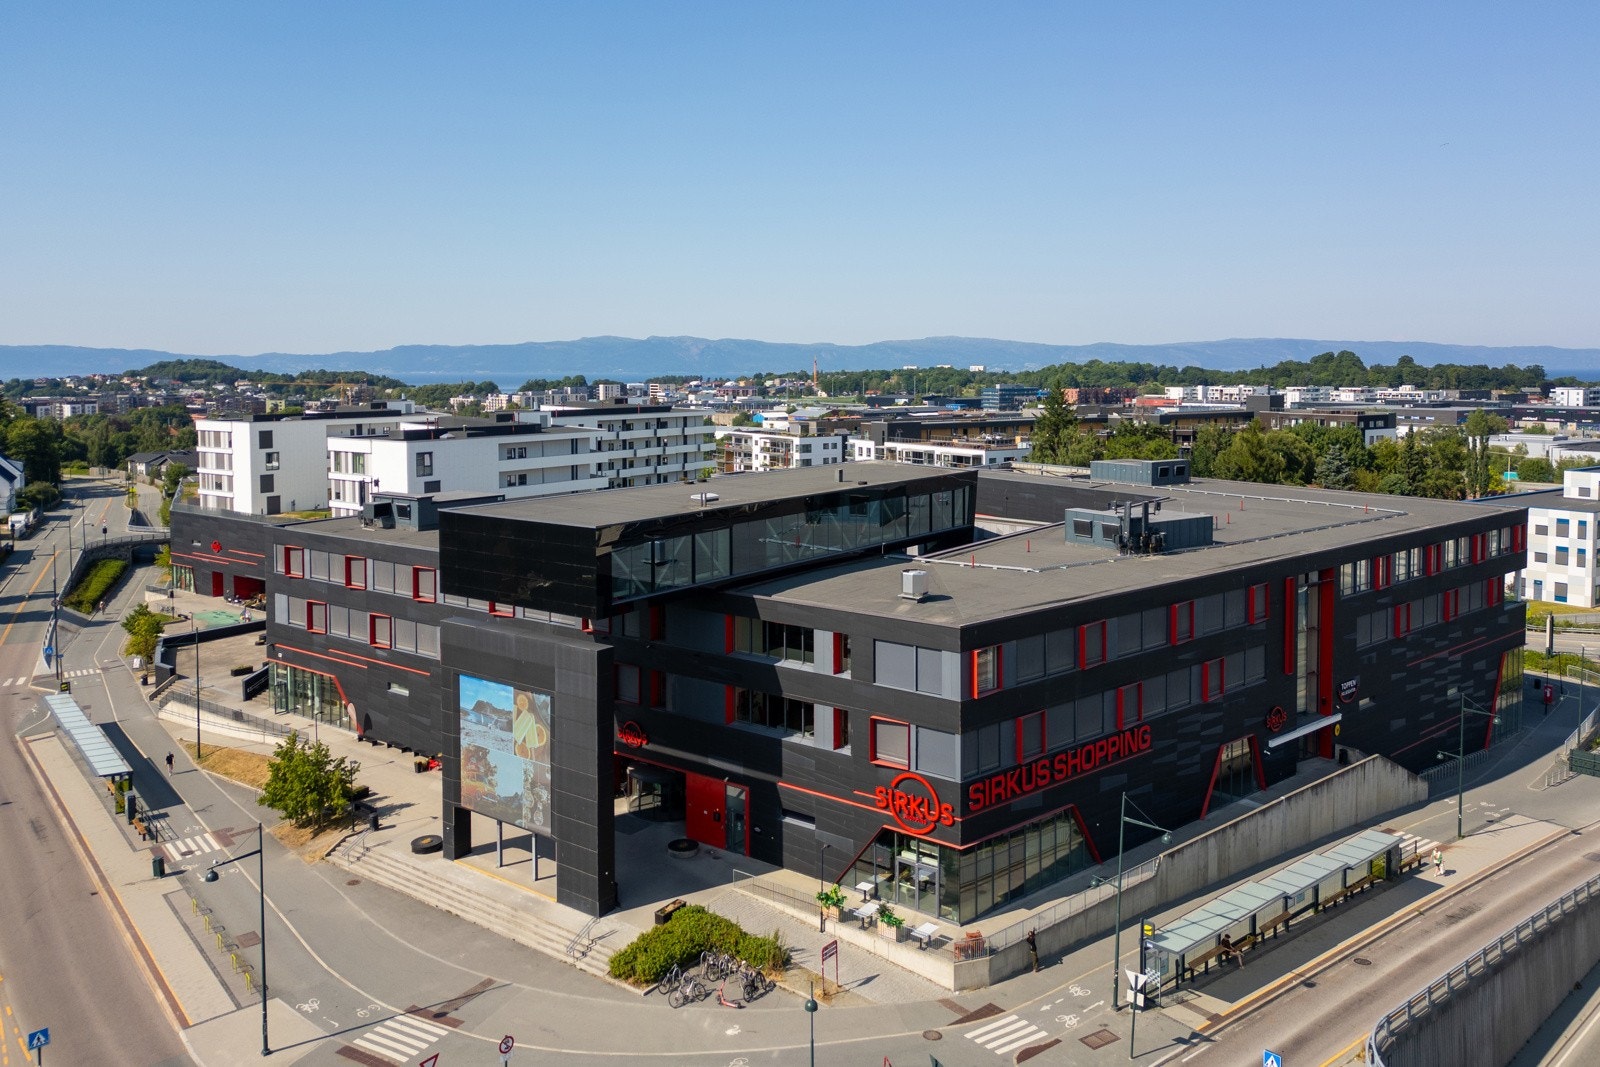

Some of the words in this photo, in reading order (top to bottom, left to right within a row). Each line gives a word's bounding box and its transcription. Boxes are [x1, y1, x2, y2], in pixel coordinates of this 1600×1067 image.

[1341, 680, 1357, 690] TOPPEN
[969, 759, 1051, 811] SIRKUS
[1053, 724, 1151, 781] SHOPPING
[875, 784, 954, 827] SIRKUS
